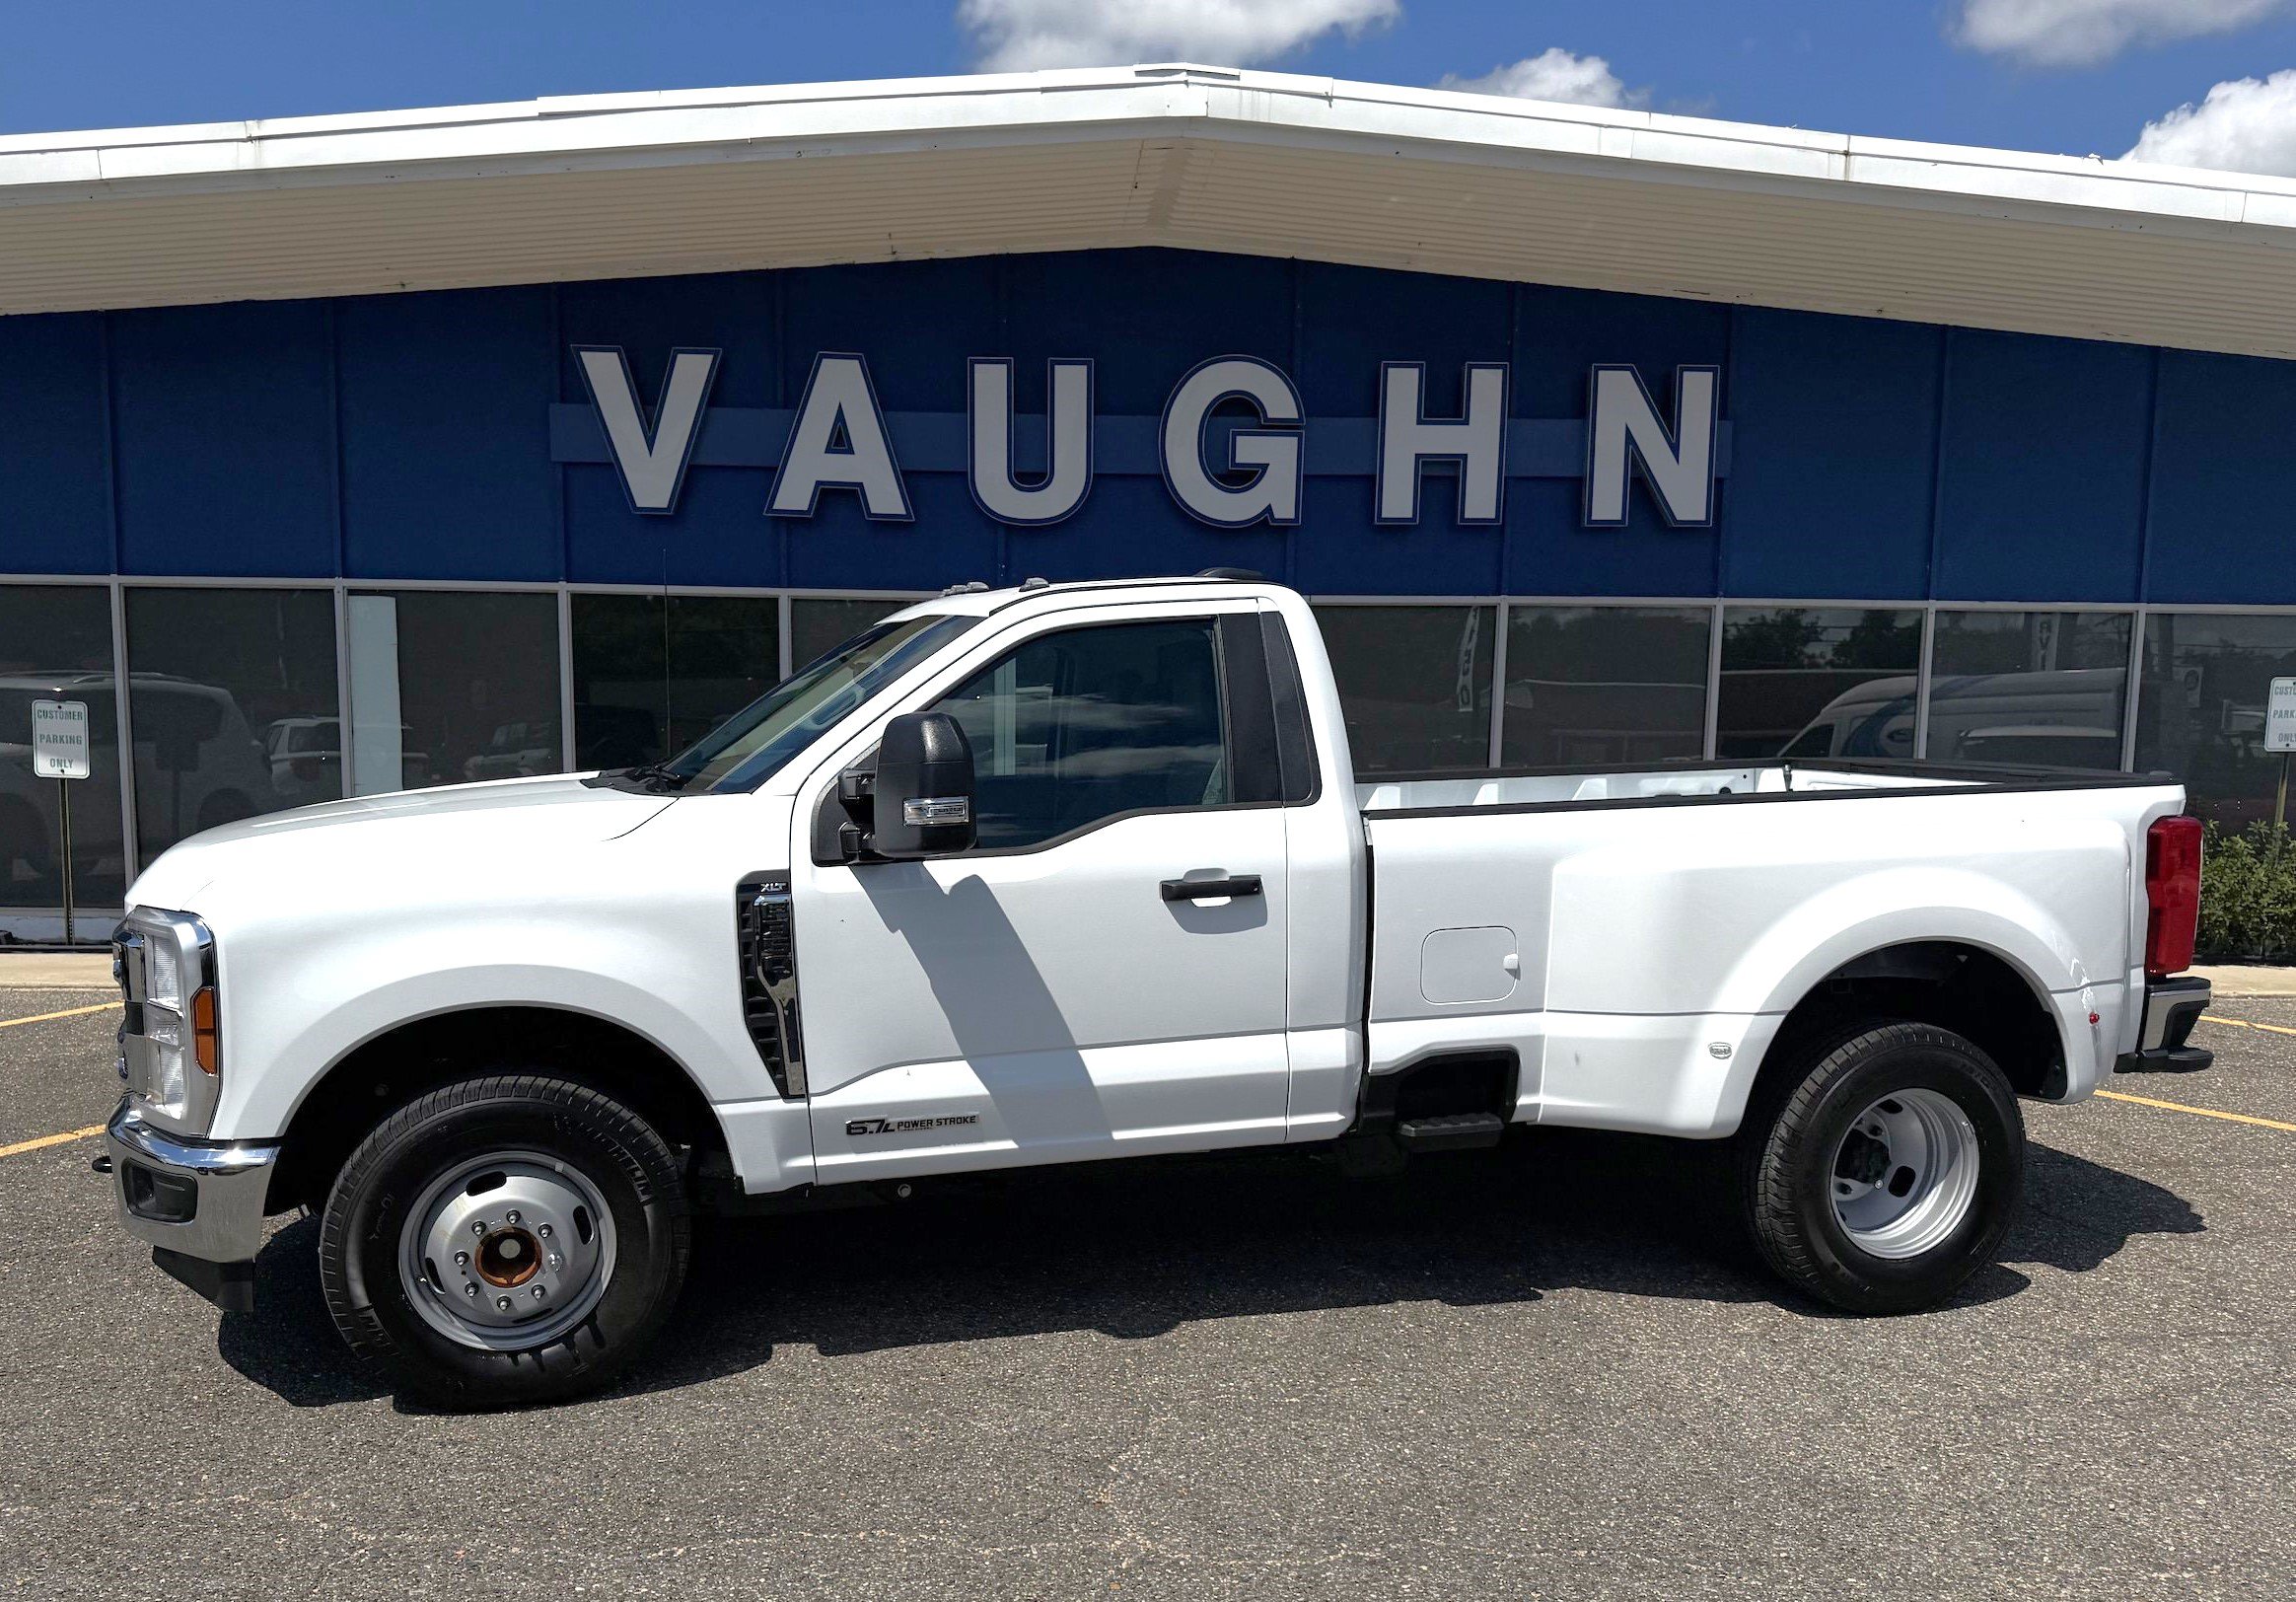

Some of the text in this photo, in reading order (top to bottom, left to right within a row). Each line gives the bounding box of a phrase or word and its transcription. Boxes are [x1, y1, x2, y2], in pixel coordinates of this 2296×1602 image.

[571, 344, 1720, 527] VAUGHN
[36, 709, 83, 721] CUSTOMER
[39, 733, 82, 745] PARKING
[49, 758, 74, 768] ONLY
[760, 882, 787, 892] XLT
[897, 1119, 934, 1129] POWER
[936, 1115, 976, 1127] STROKE
